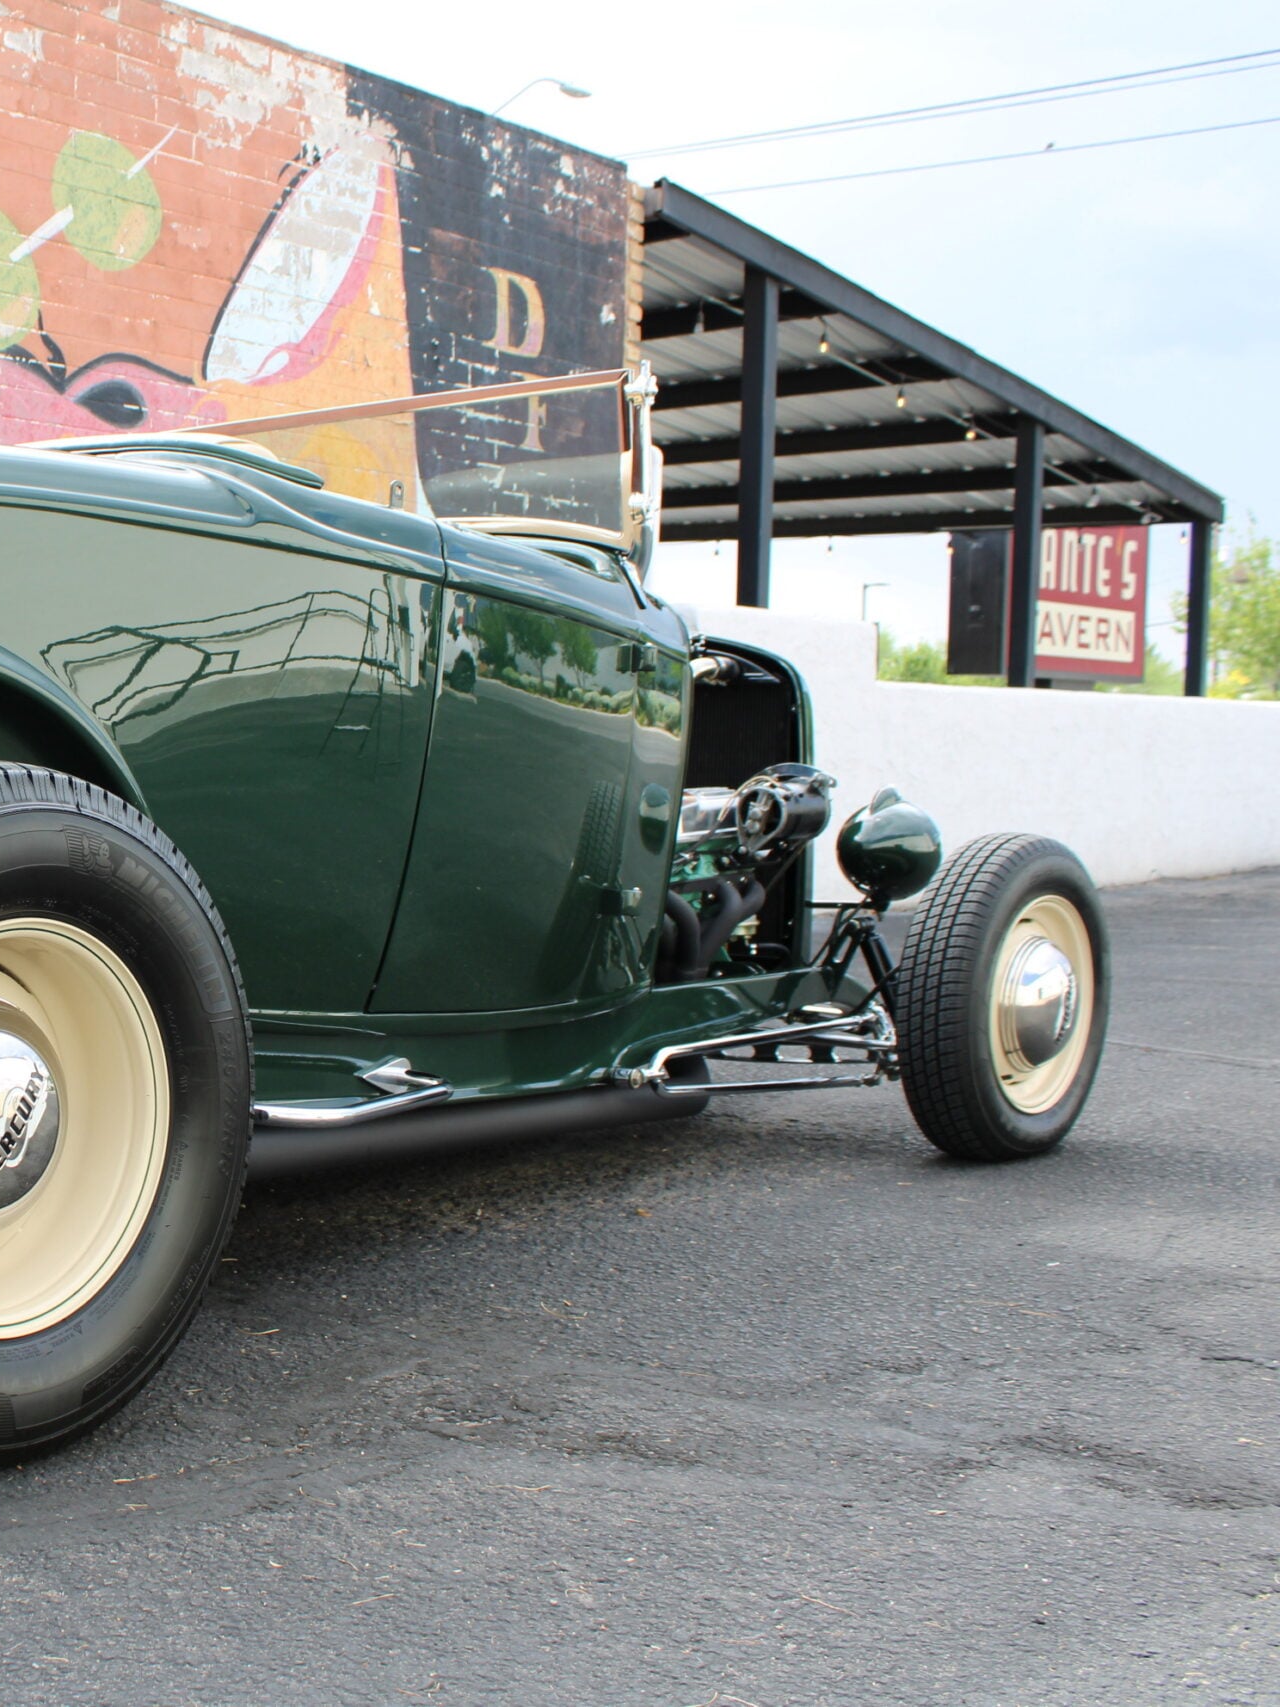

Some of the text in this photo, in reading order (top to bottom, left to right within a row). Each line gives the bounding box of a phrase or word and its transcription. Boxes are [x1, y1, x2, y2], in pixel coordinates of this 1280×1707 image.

[485, 267, 545, 358] D
[1039, 528, 1138, 600] ANTE'S
[1038, 611, 1133, 652] AVERN
[116, 855, 229, 1005] MICHELIN
